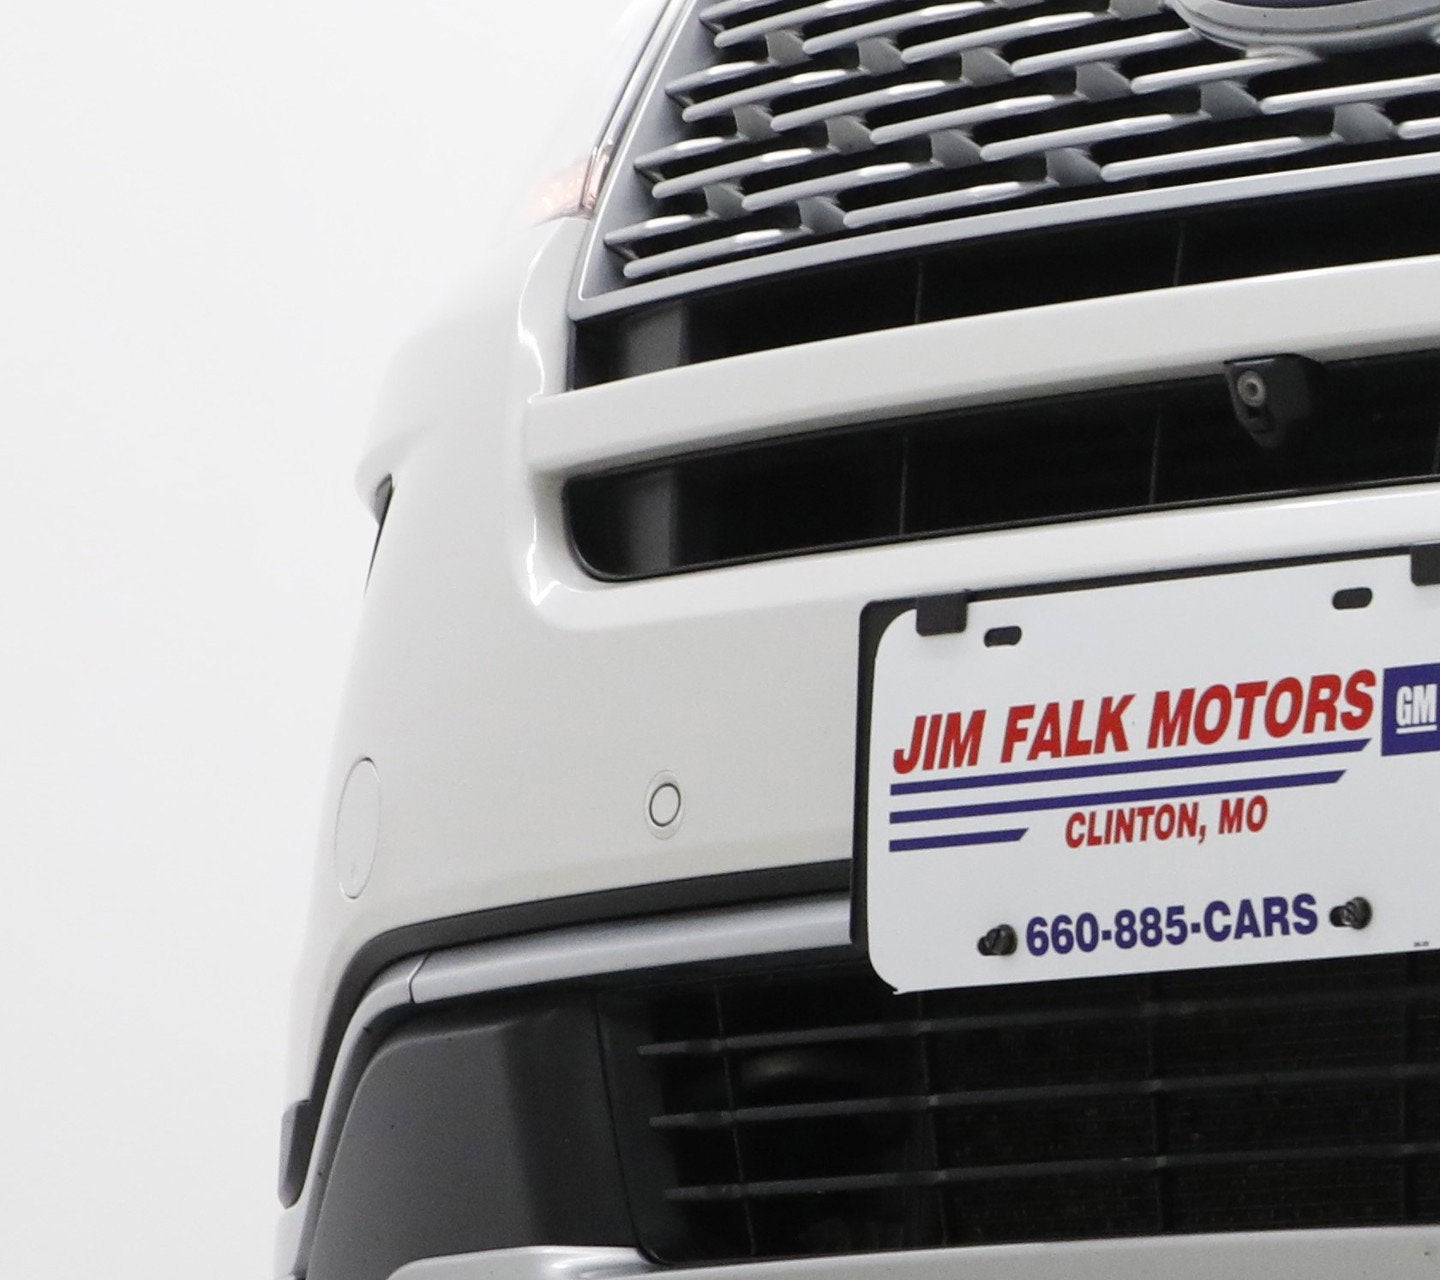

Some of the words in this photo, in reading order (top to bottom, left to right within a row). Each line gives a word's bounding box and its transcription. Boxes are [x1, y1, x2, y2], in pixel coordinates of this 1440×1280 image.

[893, 709, 986, 774] JIM
[1000, 694, 1136, 763] FALK
[1147, 669, 1376, 749] MOTORS
[1396, 683, 1438, 726] GM
[1065, 802, 1206, 849] CLINTON,
[1218, 795, 1268, 834] MO
[1026, 893, 1319, 956] 660-885-CARS
